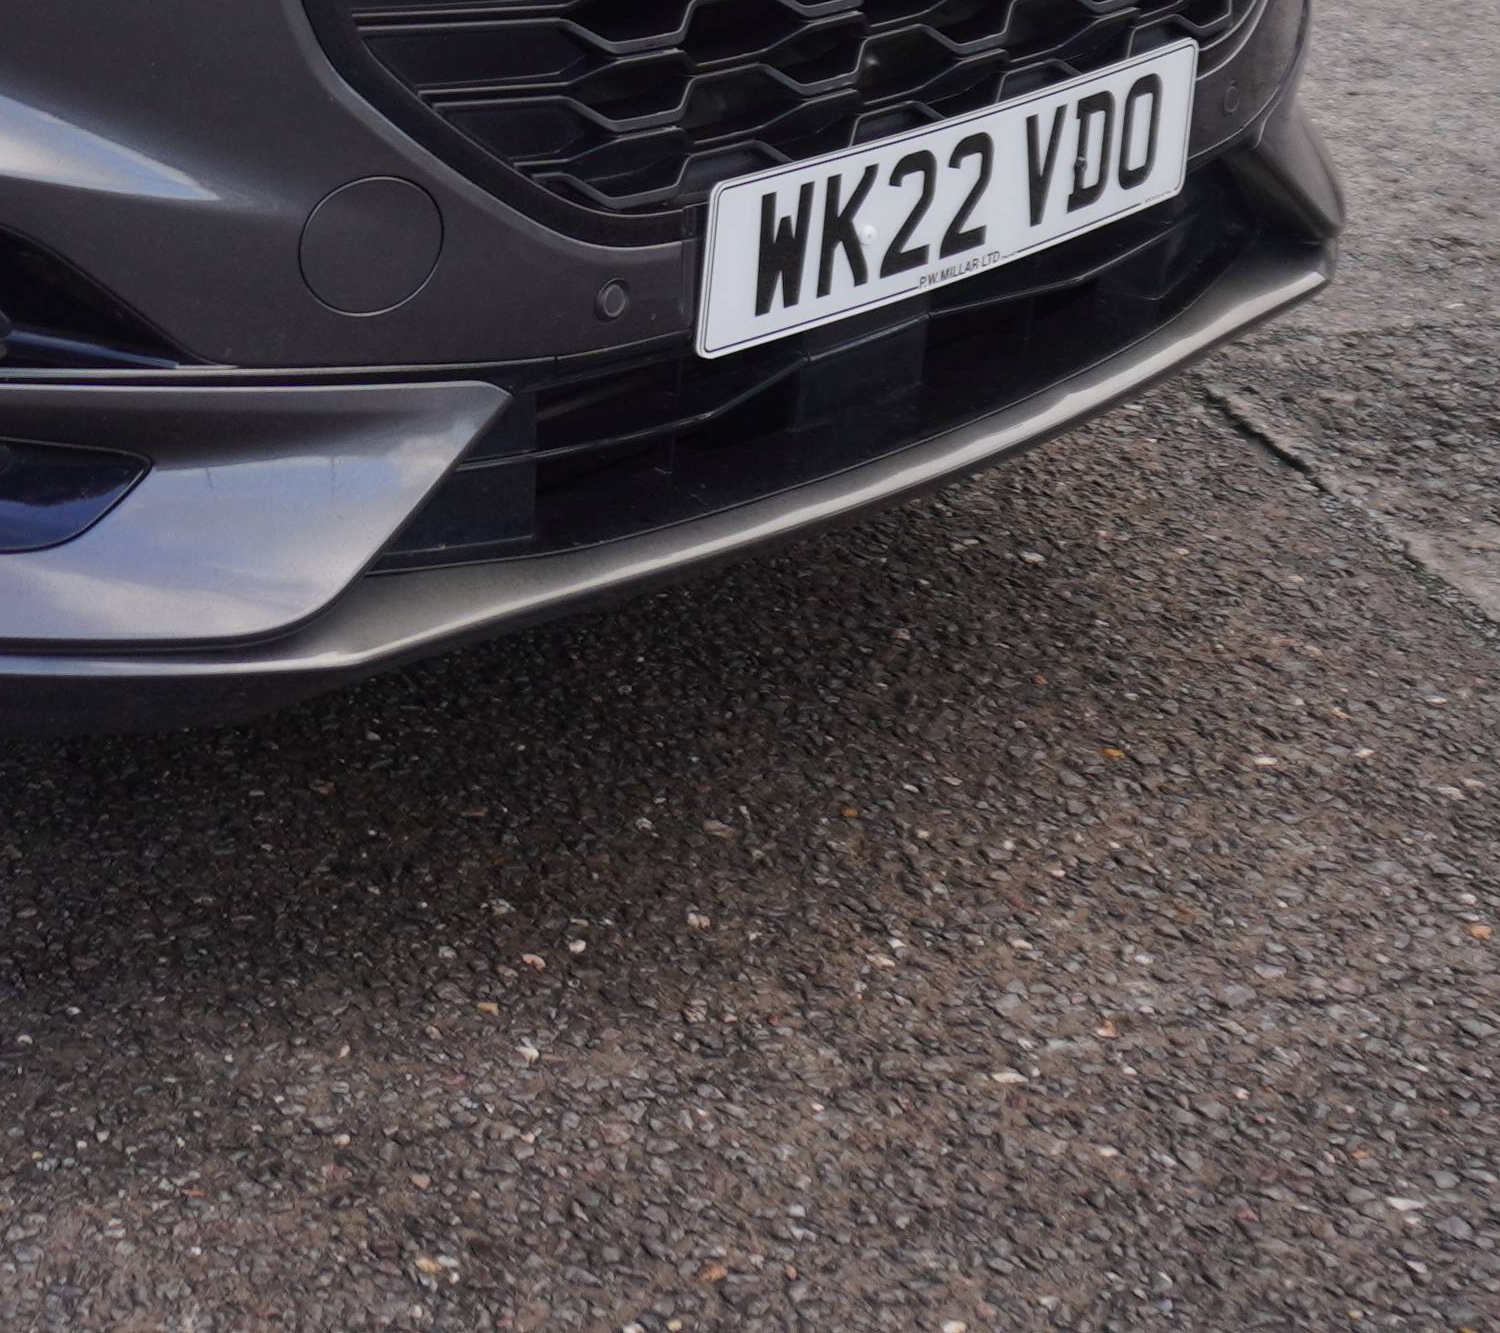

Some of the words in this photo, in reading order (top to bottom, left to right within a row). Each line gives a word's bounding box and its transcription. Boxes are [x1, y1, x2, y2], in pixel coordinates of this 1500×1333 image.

[755, 131, 995, 318] WK22
[1024, 71, 1163, 228] VDO
[981, 250, 1002, 268] LTD
